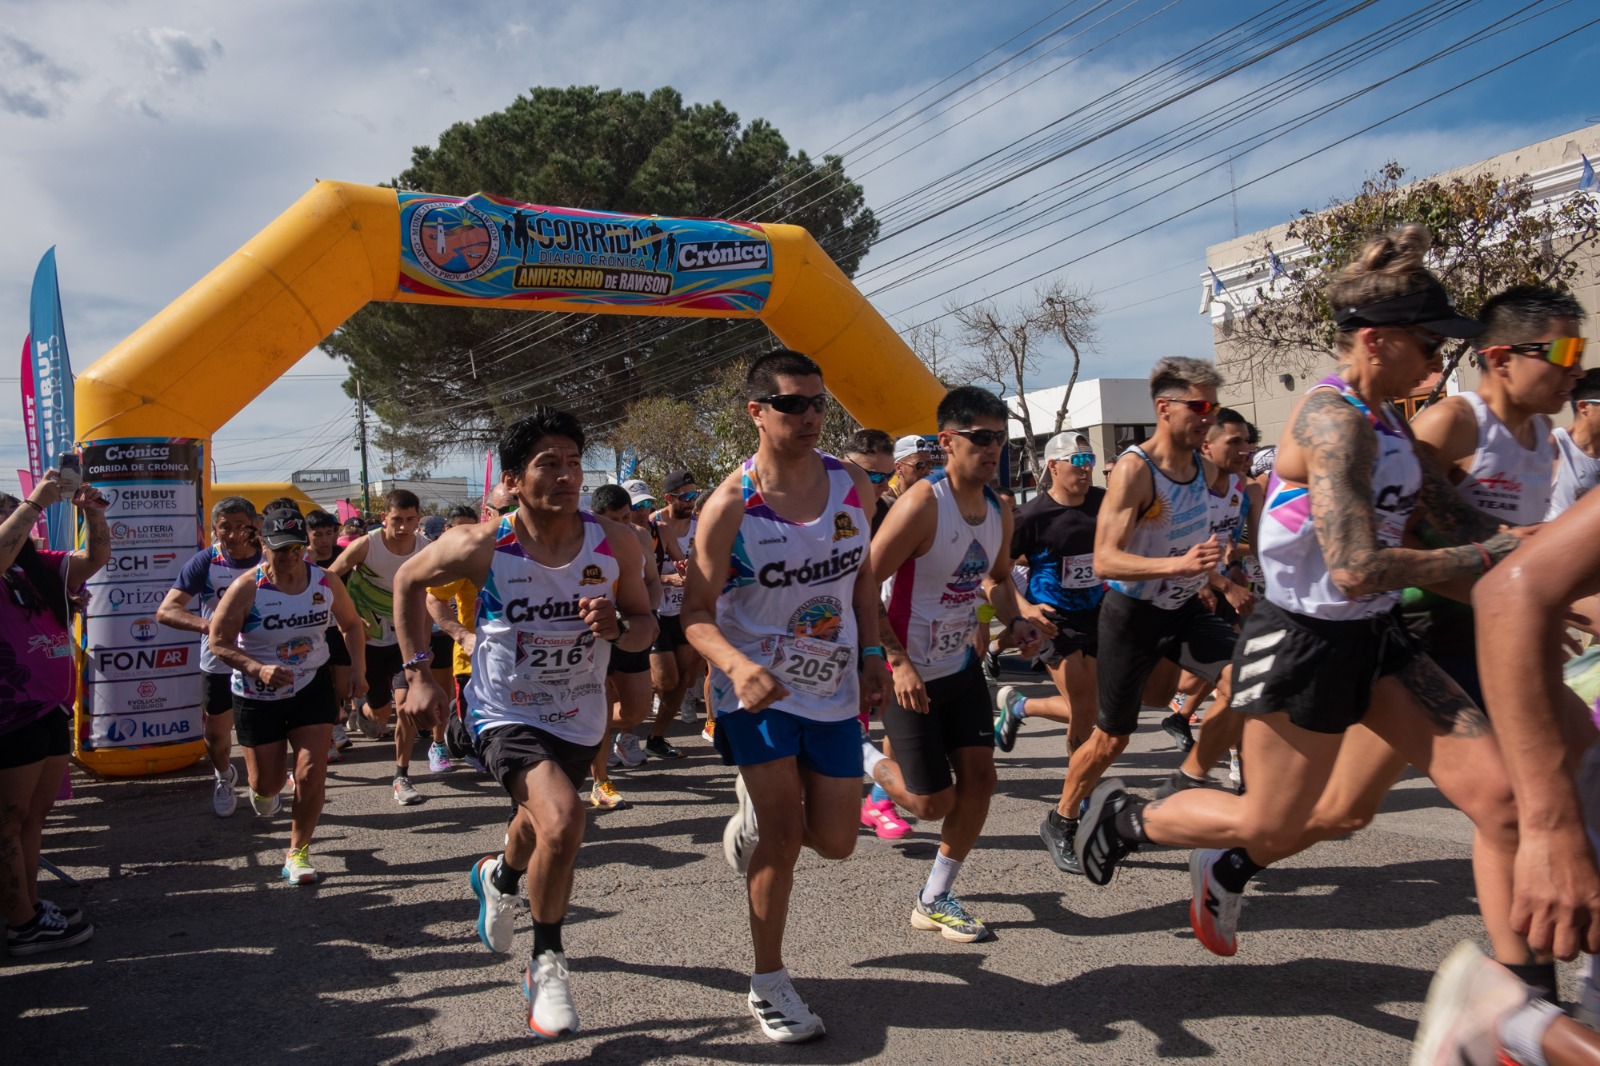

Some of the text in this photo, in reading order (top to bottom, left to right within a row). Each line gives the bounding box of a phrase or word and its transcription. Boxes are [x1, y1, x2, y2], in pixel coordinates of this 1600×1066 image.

[536, 217, 649, 256] CORRIDA
[423, 260, 432, 269] de
[431, 266, 438, 275] la
[464, 271, 476, 279] del
[476, 247, 498, 274] CHUBUT
[539, 251, 646, 270] DIARIO CRÓNICA
[679, 241, 767, 268] Crónica
[518, 267, 669, 294] ANIVERSARIO DE RAWSON
[105, 445, 170, 461] Crónica
[88, 463, 128, 474] CORRIDA
[147, 462, 189, 472] CRÓNICA
[121, 490, 176, 500] CHUBUT
[122, 500, 177, 510] DEPORTES
[137, 525, 174, 533] LOTERIA
[106, 555, 148, 571] BCH
[759, 545, 863, 588] Crónica
[109, 588, 168, 611] Orizo
[263, 610, 328, 630] Crónica
[530, 648, 583, 667] 216
[785, 655, 835, 682] 205
[132, 703, 164, 711] SEGUROS
